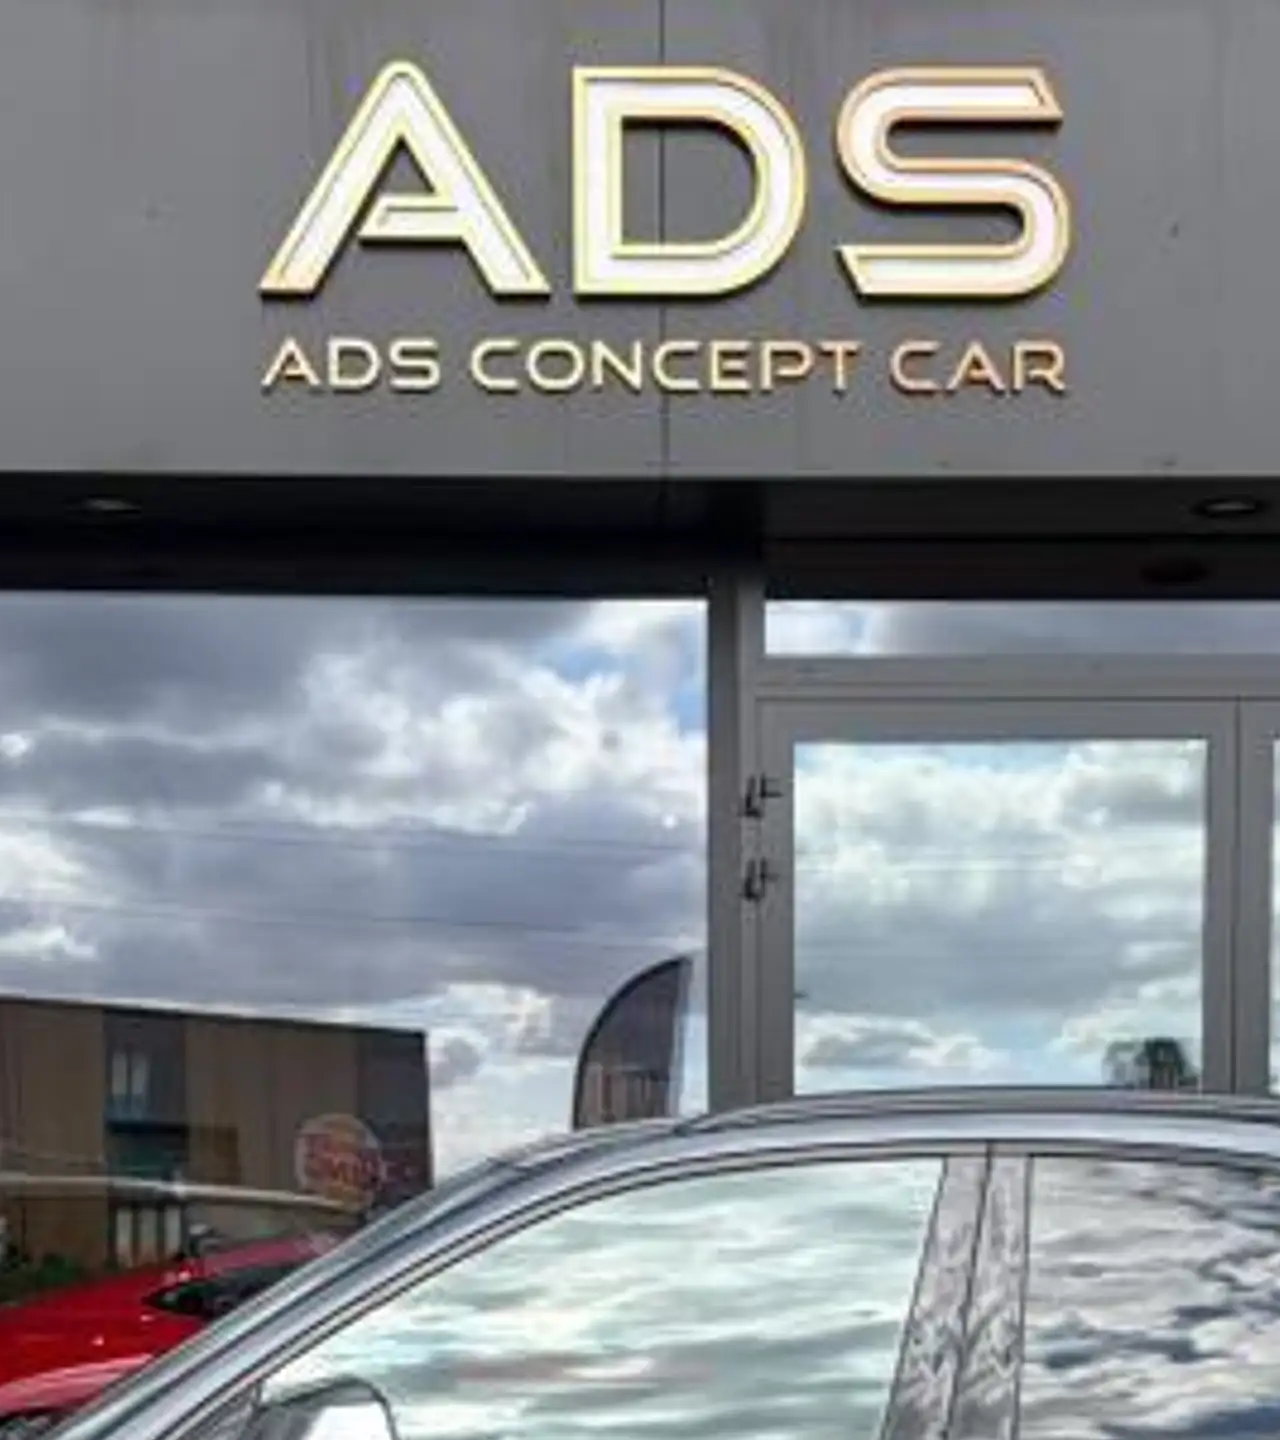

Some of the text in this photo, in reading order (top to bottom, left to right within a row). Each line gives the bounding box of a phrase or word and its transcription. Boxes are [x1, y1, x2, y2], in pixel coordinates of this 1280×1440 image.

[259, 60, 1071, 299] ADS
[261, 336, 1067, 394] ADS CONCEPT CAR
